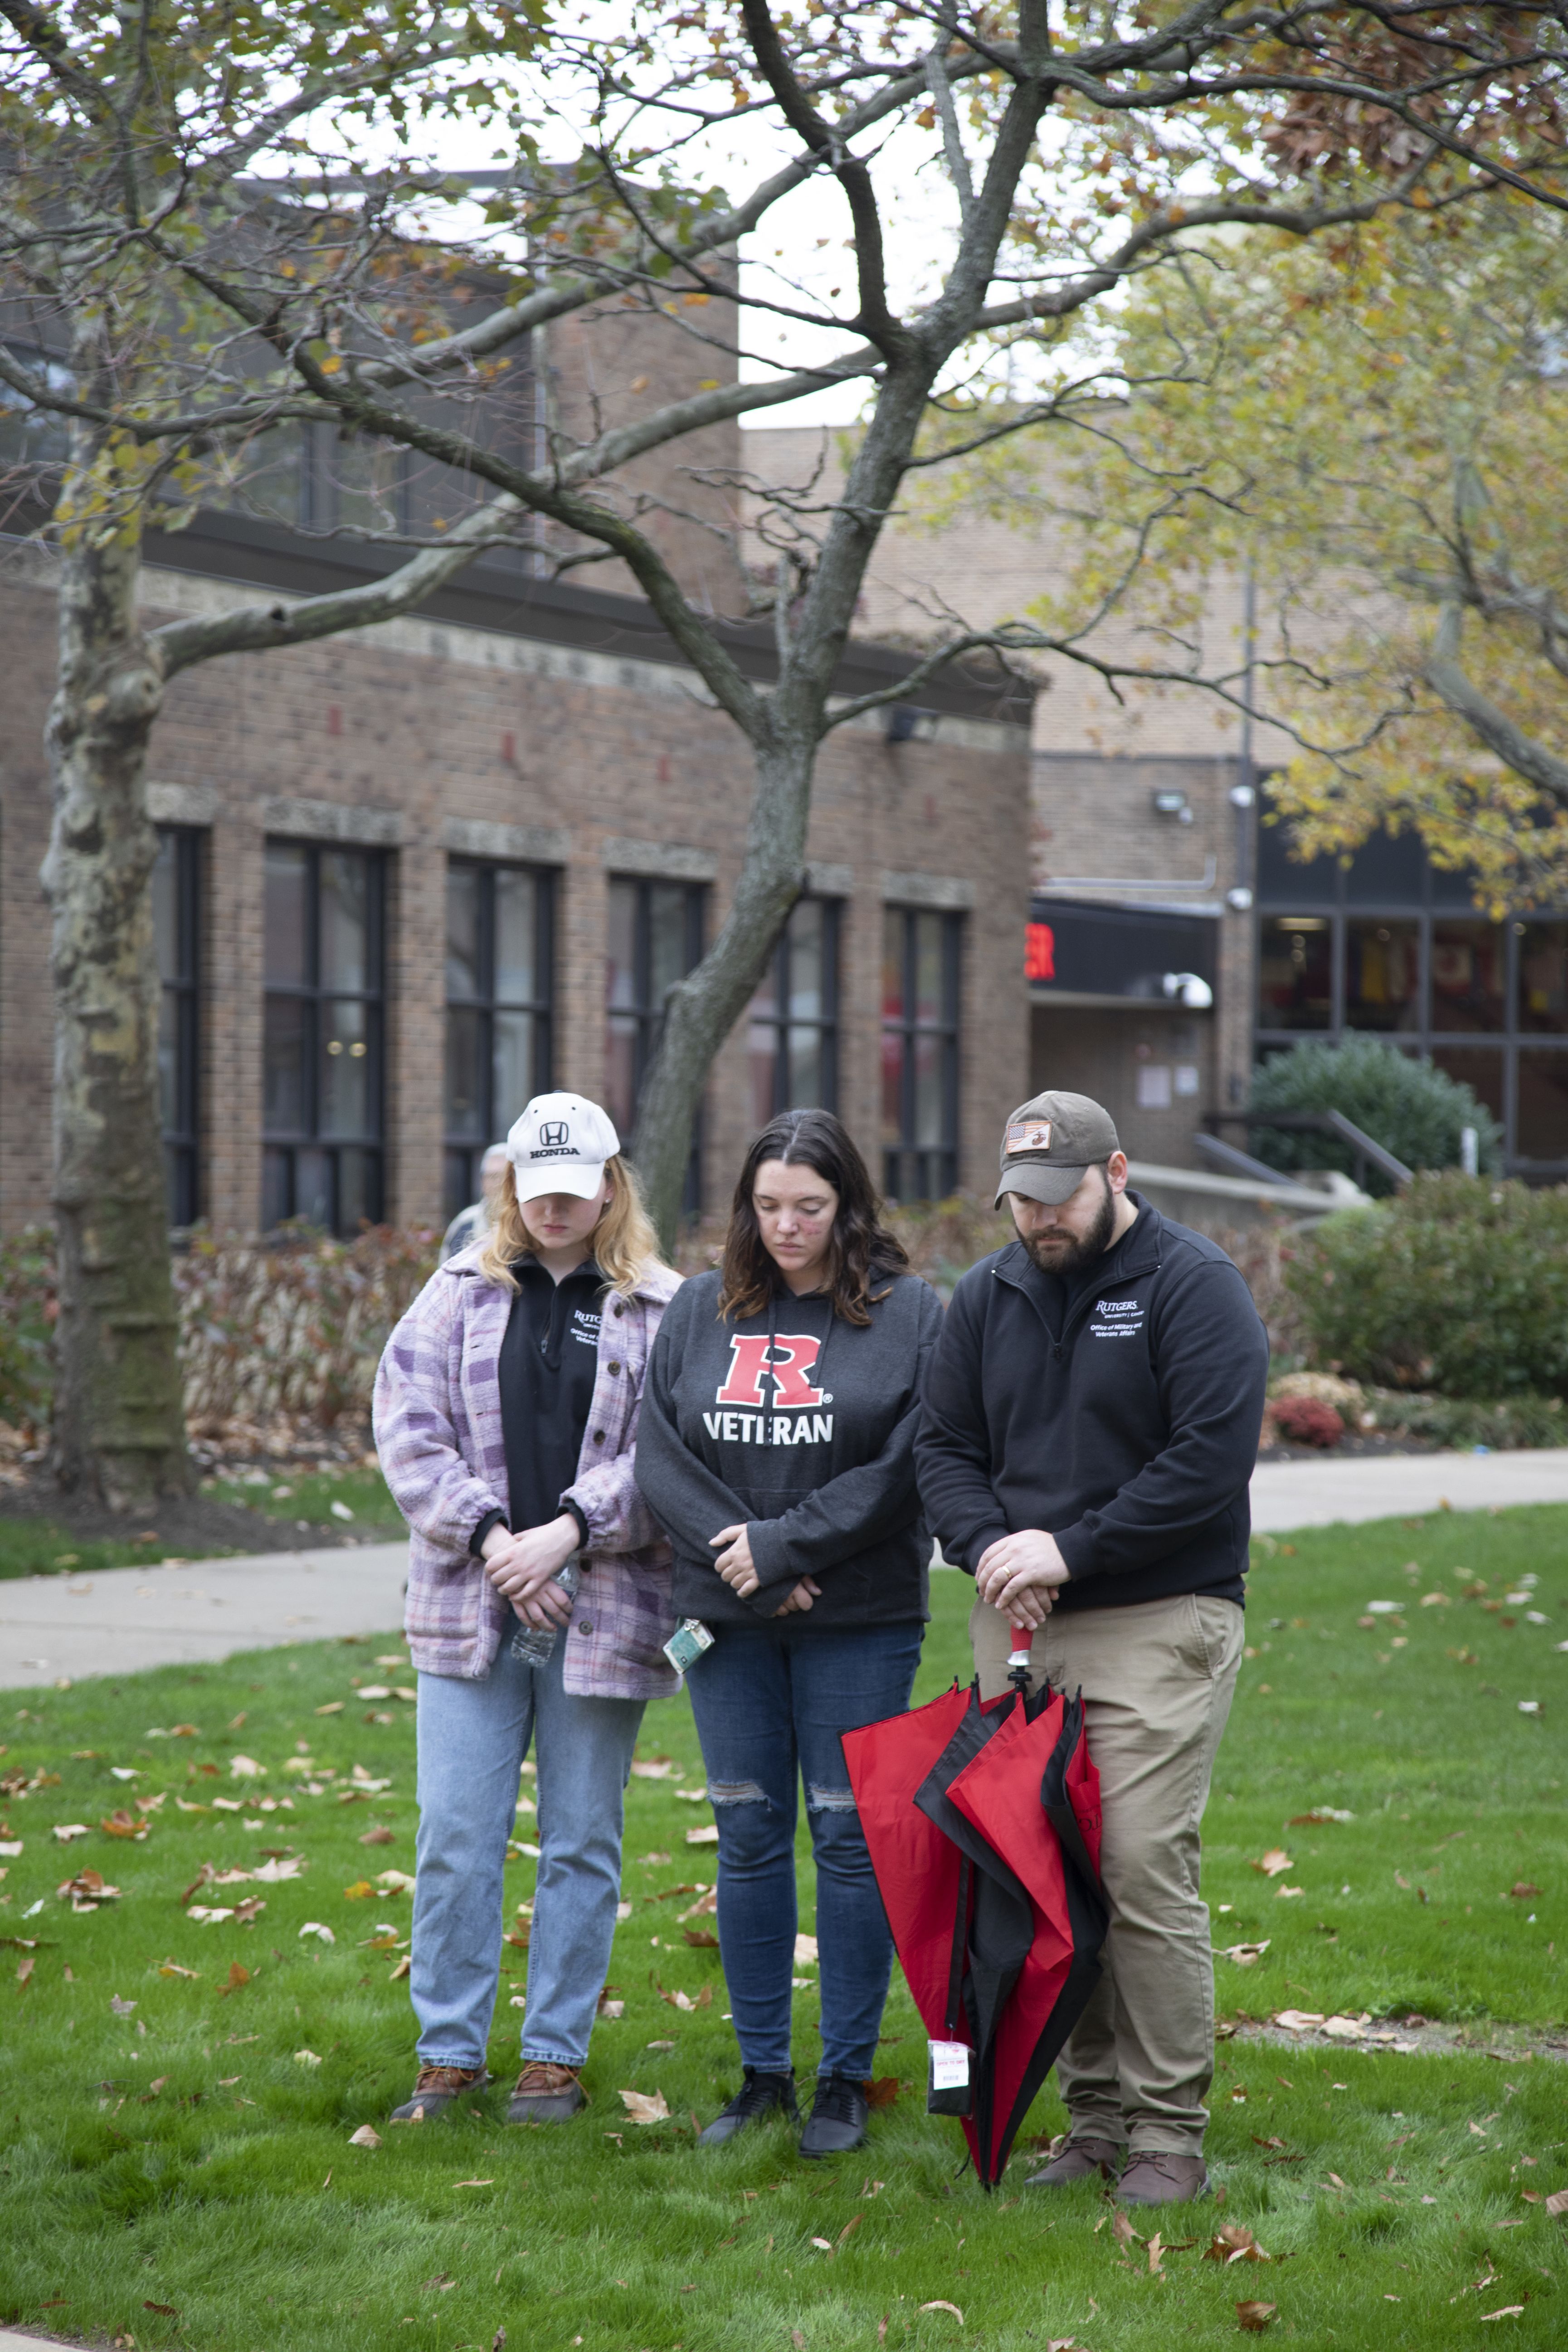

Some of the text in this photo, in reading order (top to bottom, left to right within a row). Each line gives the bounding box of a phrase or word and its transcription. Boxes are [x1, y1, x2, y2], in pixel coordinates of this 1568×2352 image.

[530, 1148, 580, 1159] HONDA
[1096, 1300, 1138, 1315] RUTGERS
[703, 1412, 833, 1445] VETERAN
